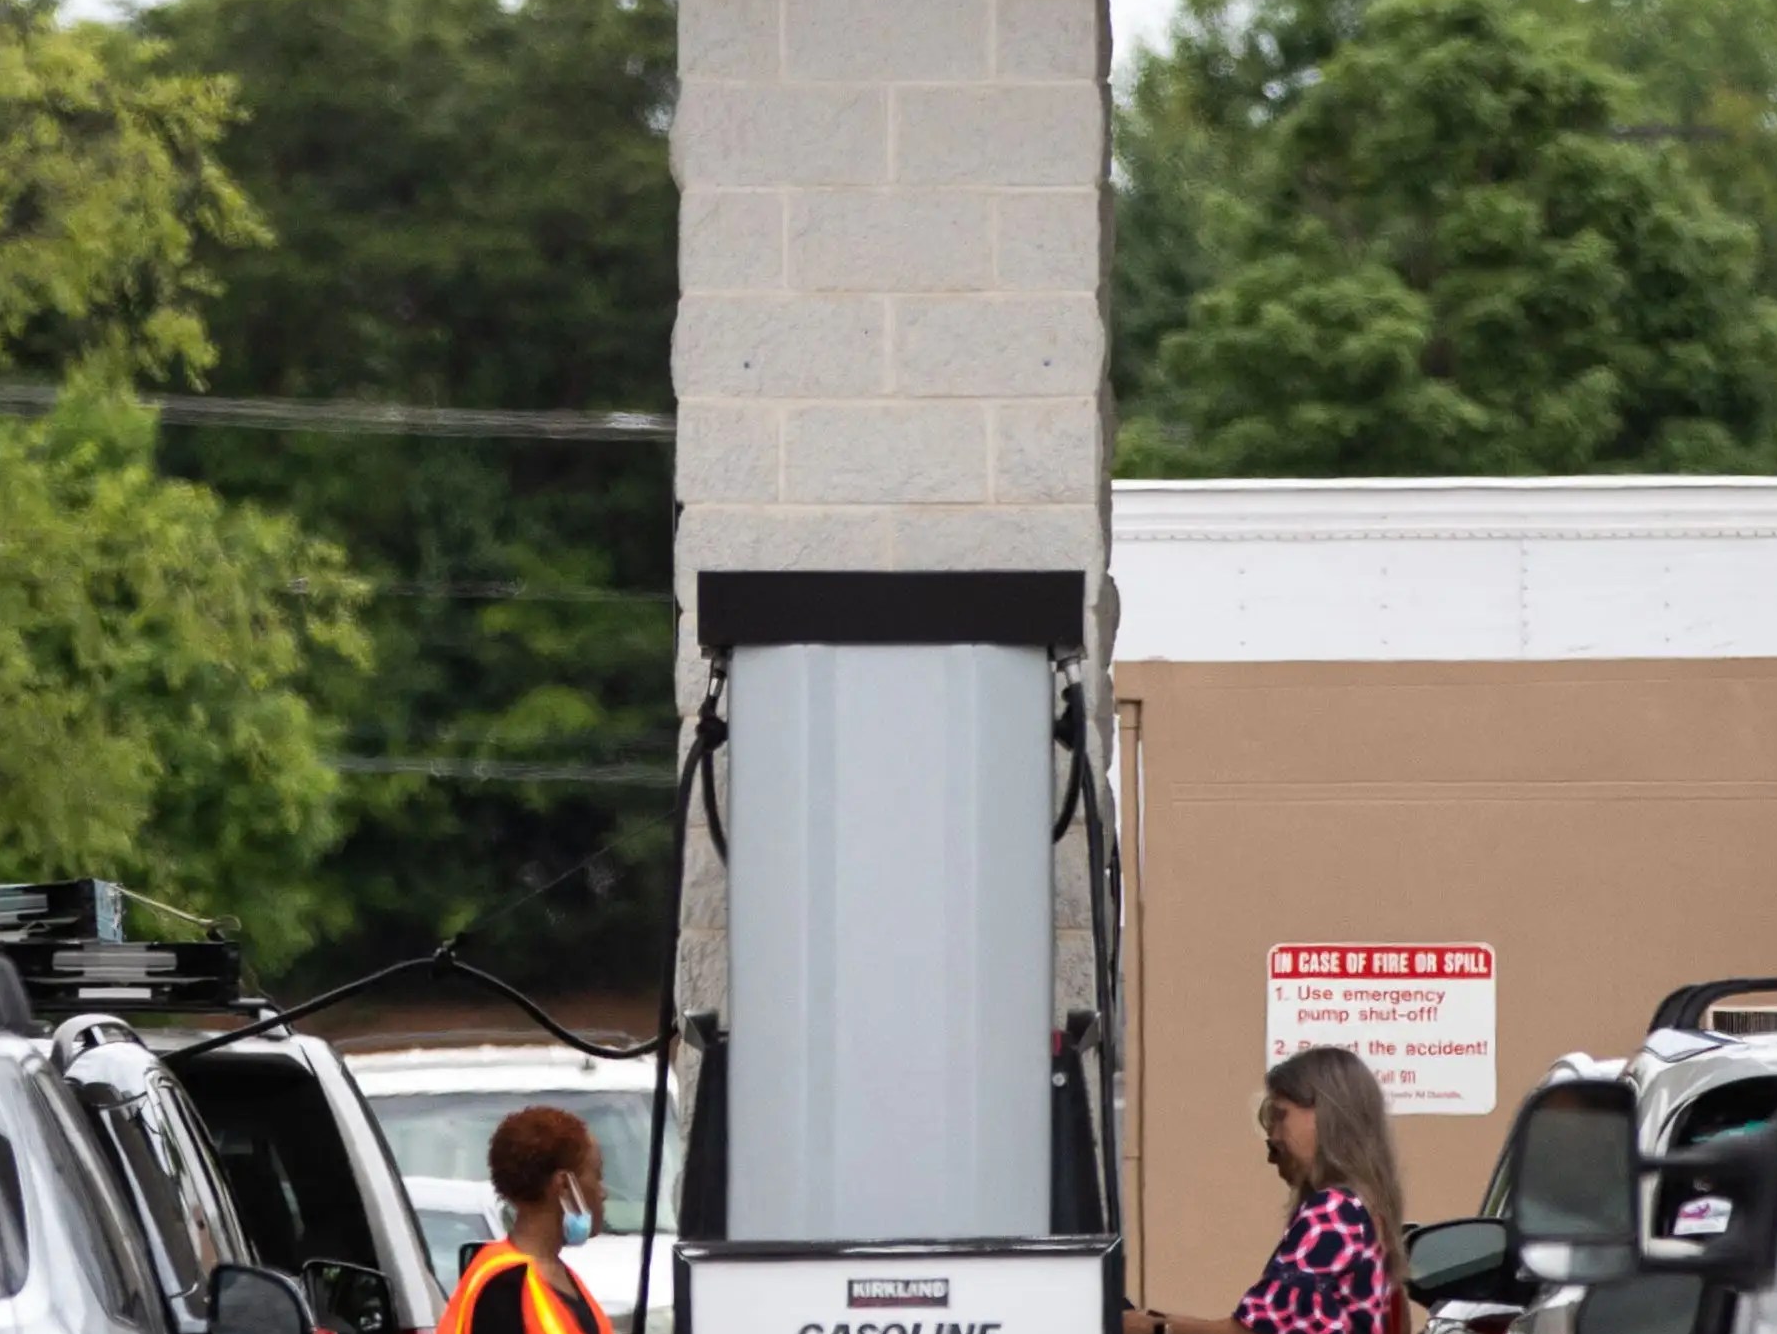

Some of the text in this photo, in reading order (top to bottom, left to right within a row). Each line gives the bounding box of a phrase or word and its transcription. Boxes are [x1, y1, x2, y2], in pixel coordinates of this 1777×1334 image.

[1274, 951, 1488, 973] IN CASE OF FIRE OR SPILL
[1297, 985, 1333, 1001] Use
[1343, 988, 1446, 1004] emergency
[1297, 1006, 1438, 1024] pump shut-off!
[1368, 1040, 1397, 1055] the
[1406, 1040, 1488, 1055] accident!
[1400, 1070, 1416, 1084] 911
[852, 1281, 947, 1298] KIRKLAND
